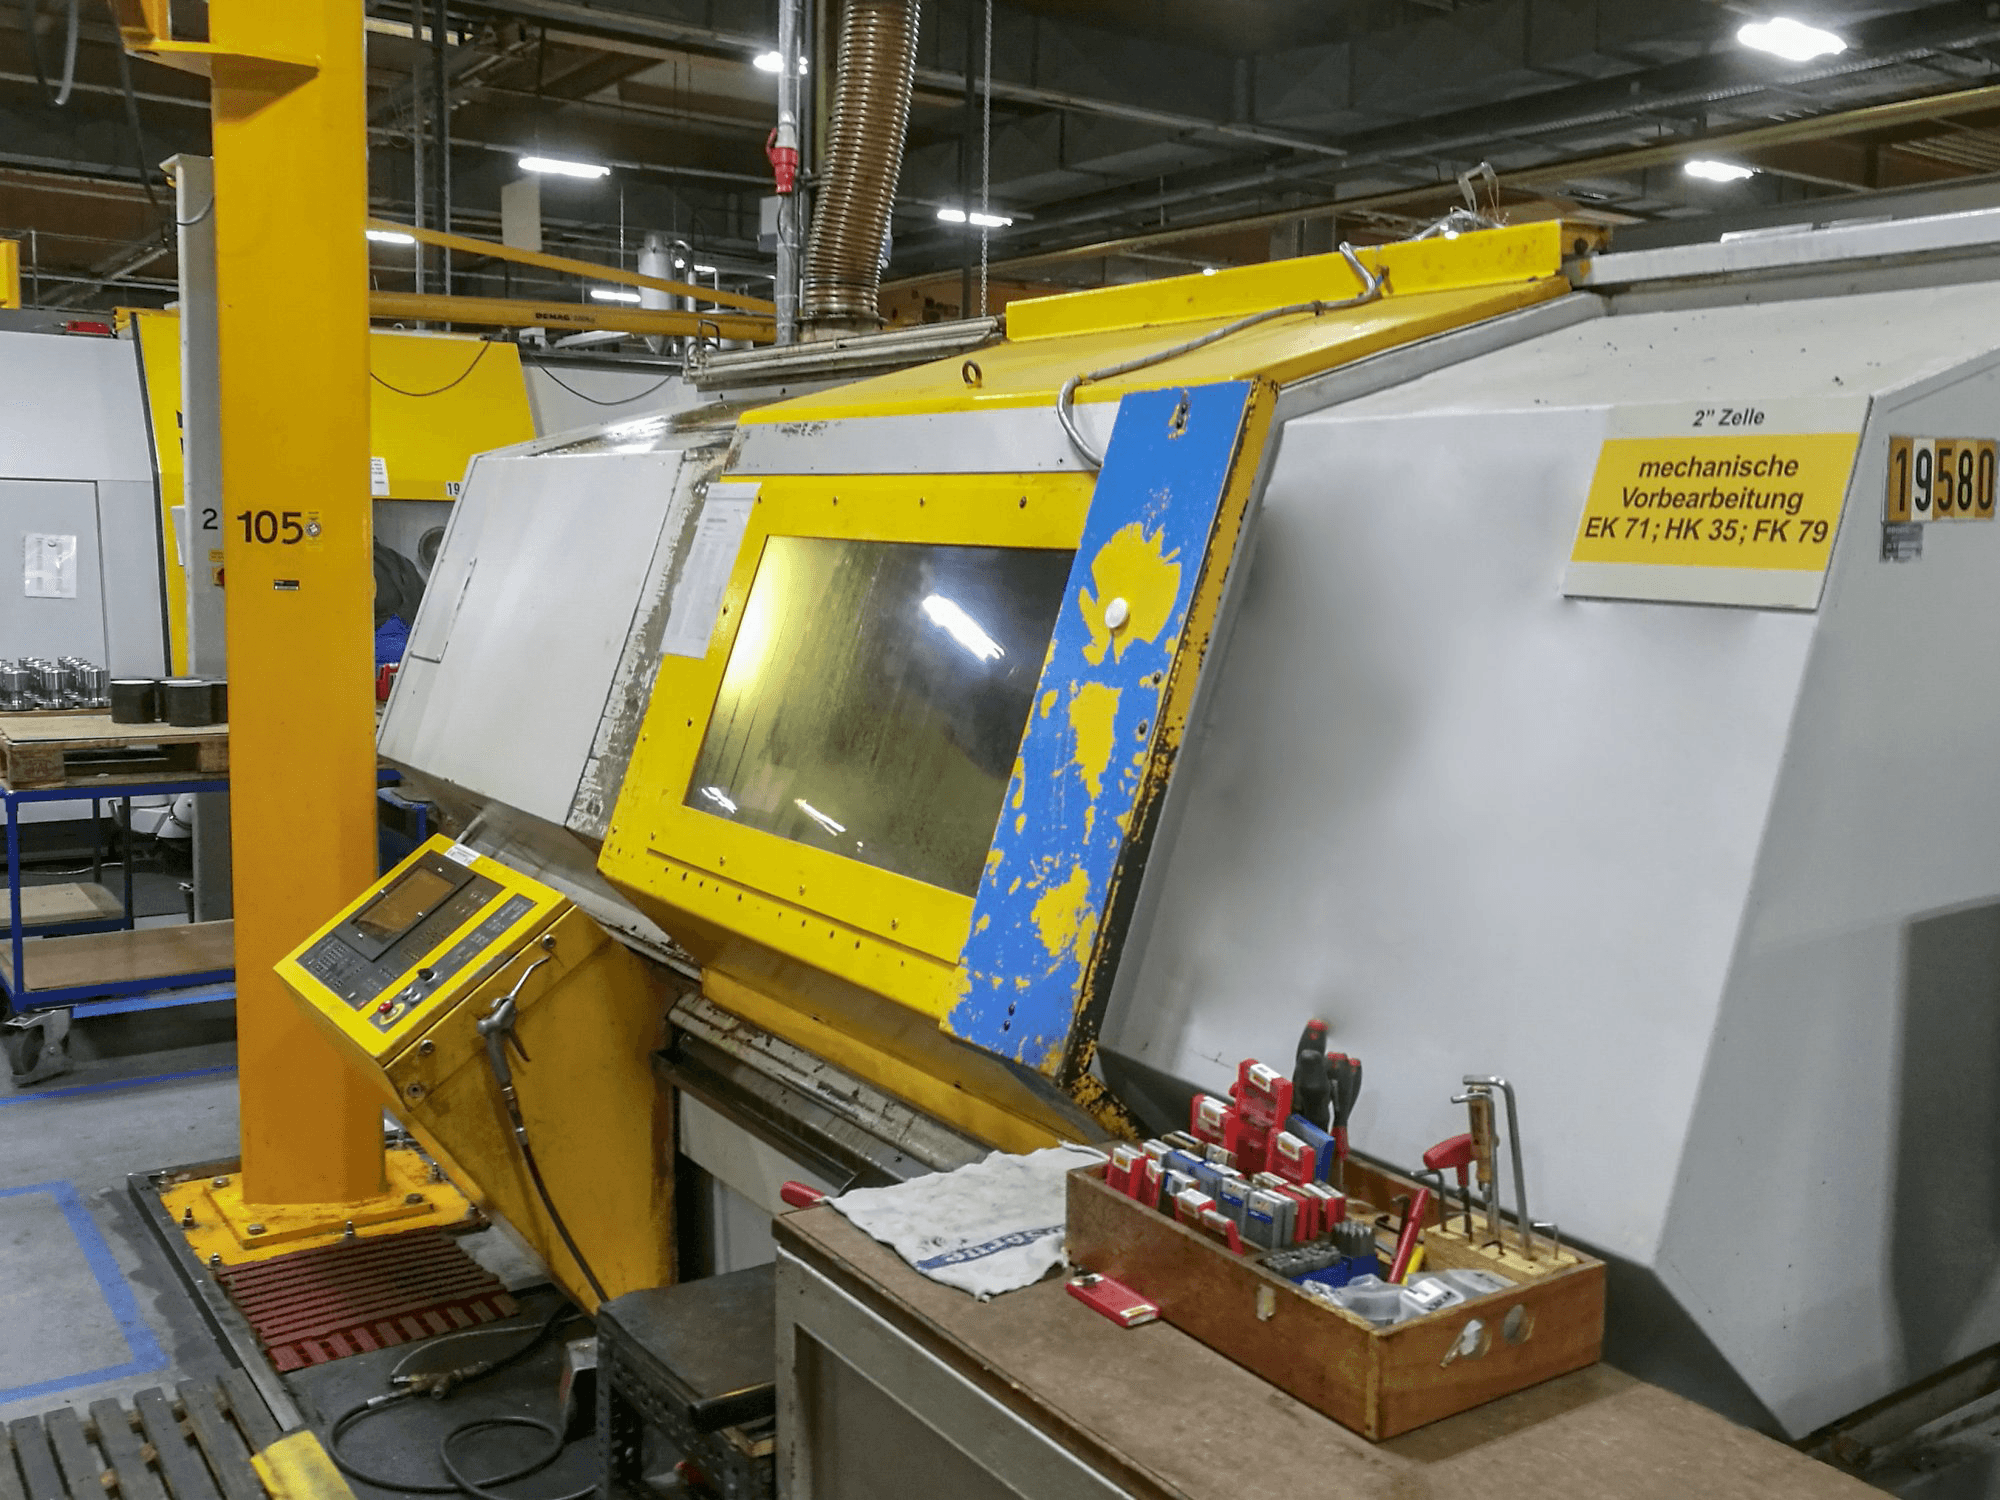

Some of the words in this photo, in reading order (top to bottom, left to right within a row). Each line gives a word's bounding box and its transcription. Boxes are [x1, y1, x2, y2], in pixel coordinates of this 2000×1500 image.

[1718, 408, 1765, 427] Zelle
[1638, 454, 1800, 479] mechanische
[1895, 447, 1995, 512] 19580
[1621, 486, 1805, 516] Vorbearbeitung
[202, 508, 218, 530] 2
[236, 509, 304, 545] 105
[1584, 516, 1621, 539] EK
[1664, 517, 1704, 541] HK
[1752, 519, 1793, 543] FK
[1798, 519, 1829, 544] 79
